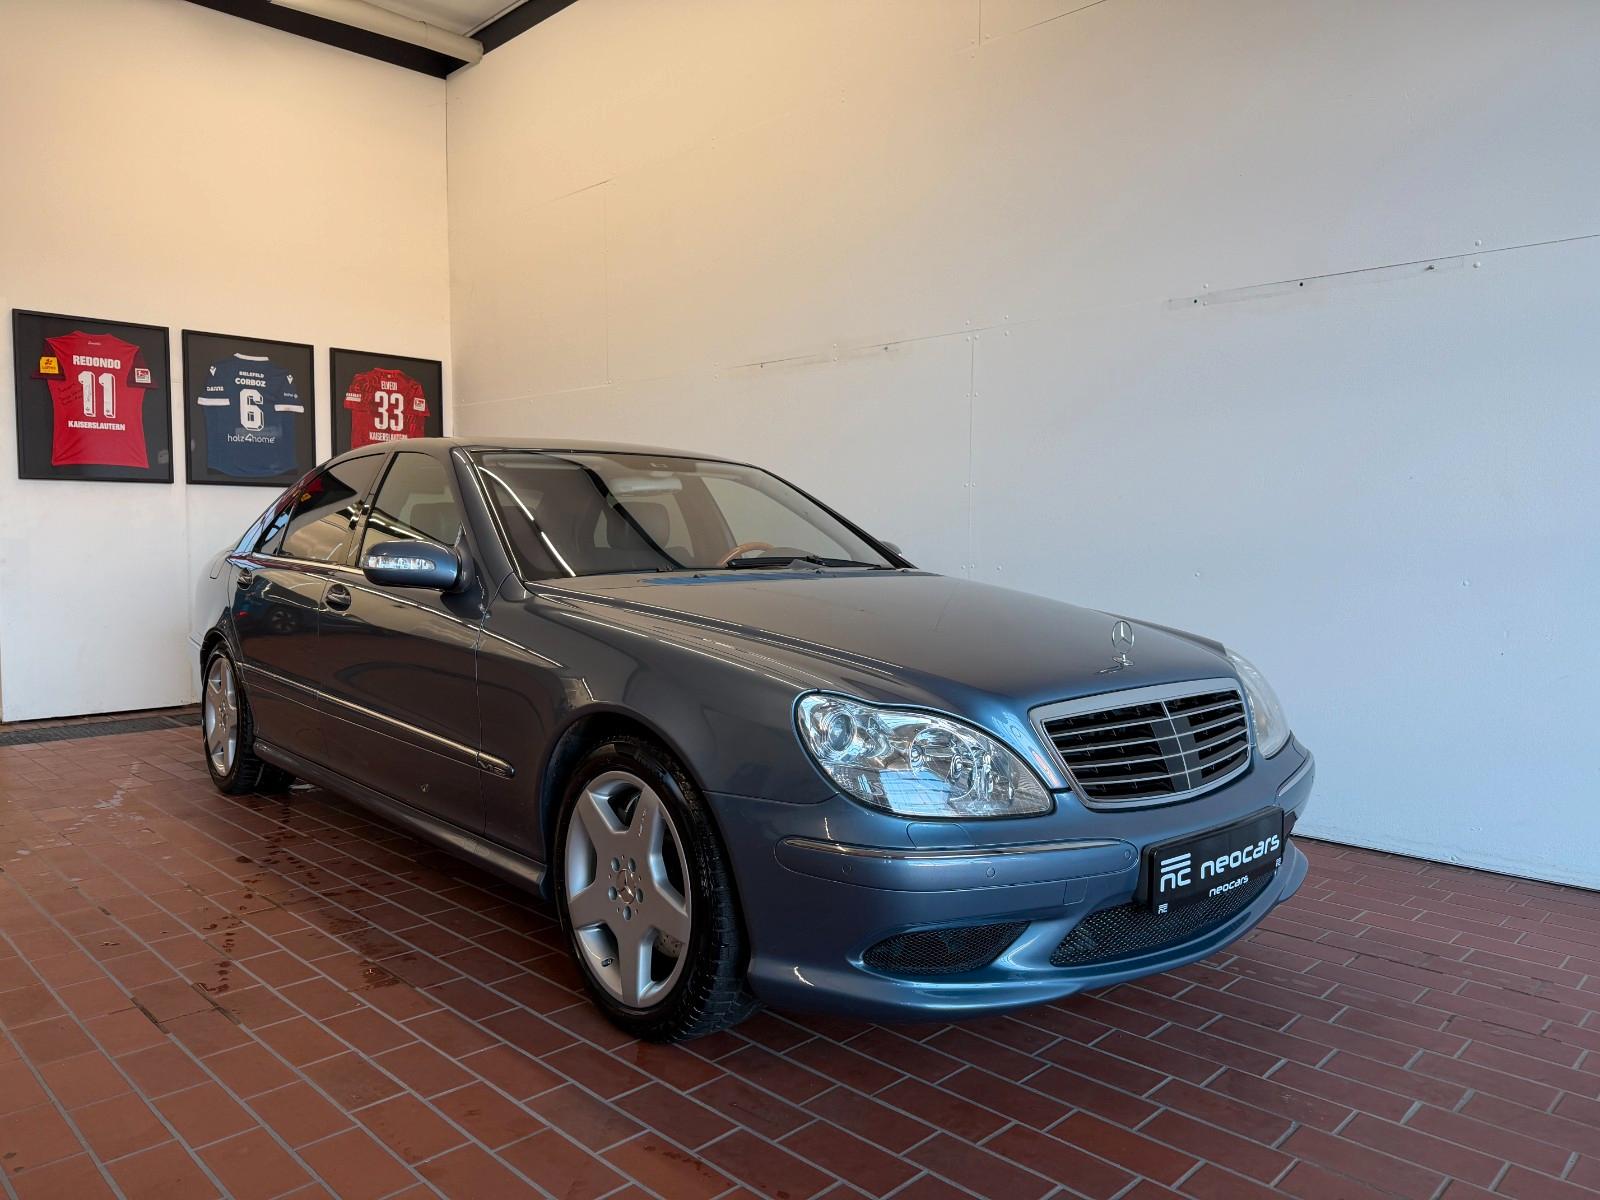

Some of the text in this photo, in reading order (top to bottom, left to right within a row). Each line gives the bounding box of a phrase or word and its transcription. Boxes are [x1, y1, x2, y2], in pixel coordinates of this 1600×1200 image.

[72, 355, 121, 369] REDONDO
[77, 370, 117, 419] 11
[234, 377, 268, 388] CORBOZ
[68, 420, 125, 431] KAISERSLAUTERN
[239, 388, 265, 432] 6
[374, 391, 405, 432] 33
[1200, 834, 1280, 879] neocars
[1209, 875, 1249, 897] neocars
